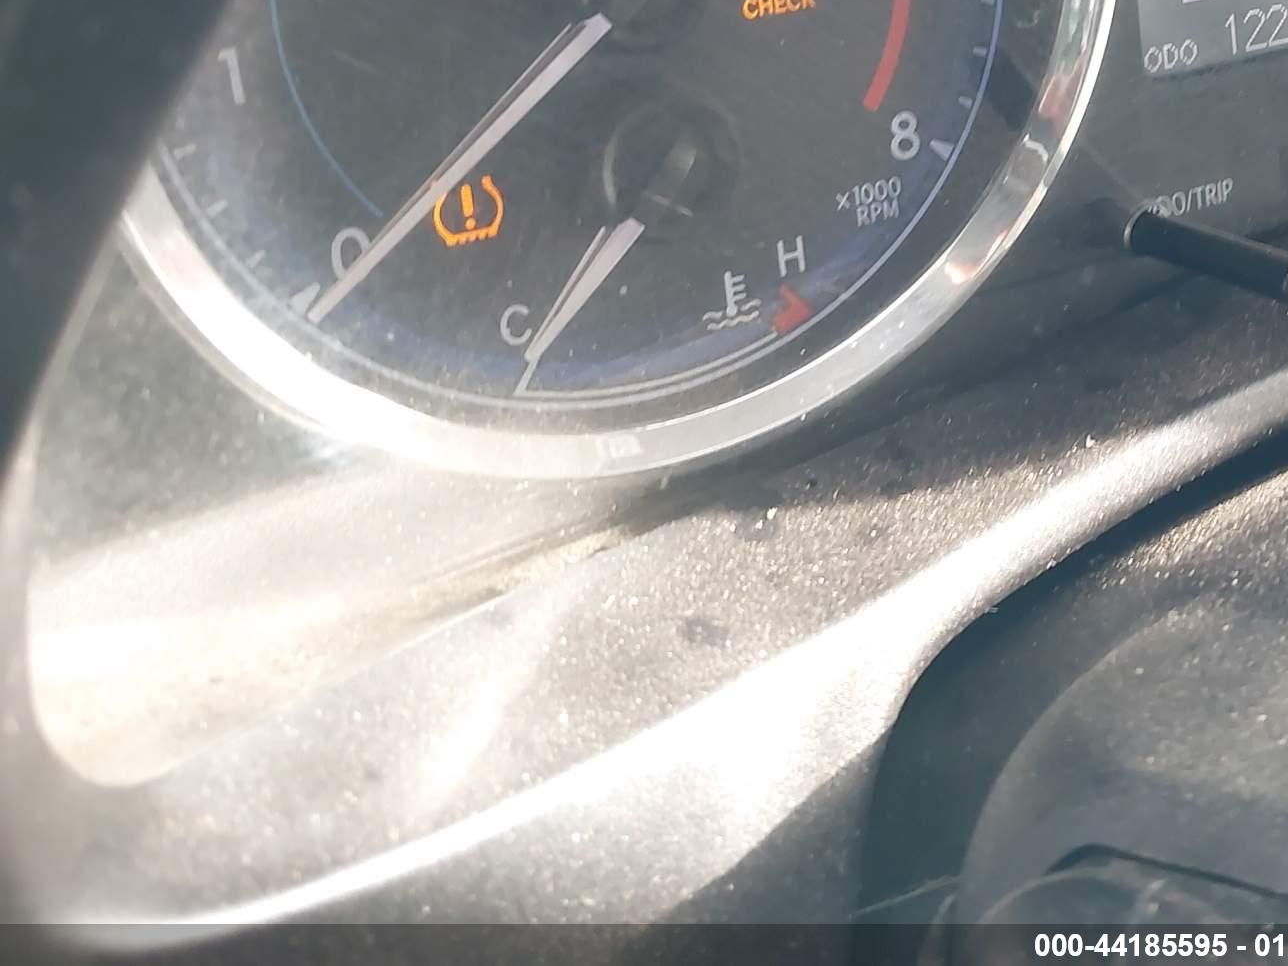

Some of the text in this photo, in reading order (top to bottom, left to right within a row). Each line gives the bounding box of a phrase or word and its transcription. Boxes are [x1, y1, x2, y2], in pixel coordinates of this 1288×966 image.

[217, 46, 246, 105] 1
[1142, 37, 1199, 74] ODO
[890, 109, 921, 161] 8
[855, 199, 900, 227] RPM
[330, 226, 373, 281] 0
[776, 234, 806, 278] H
[499, 304, 533, 347] C
